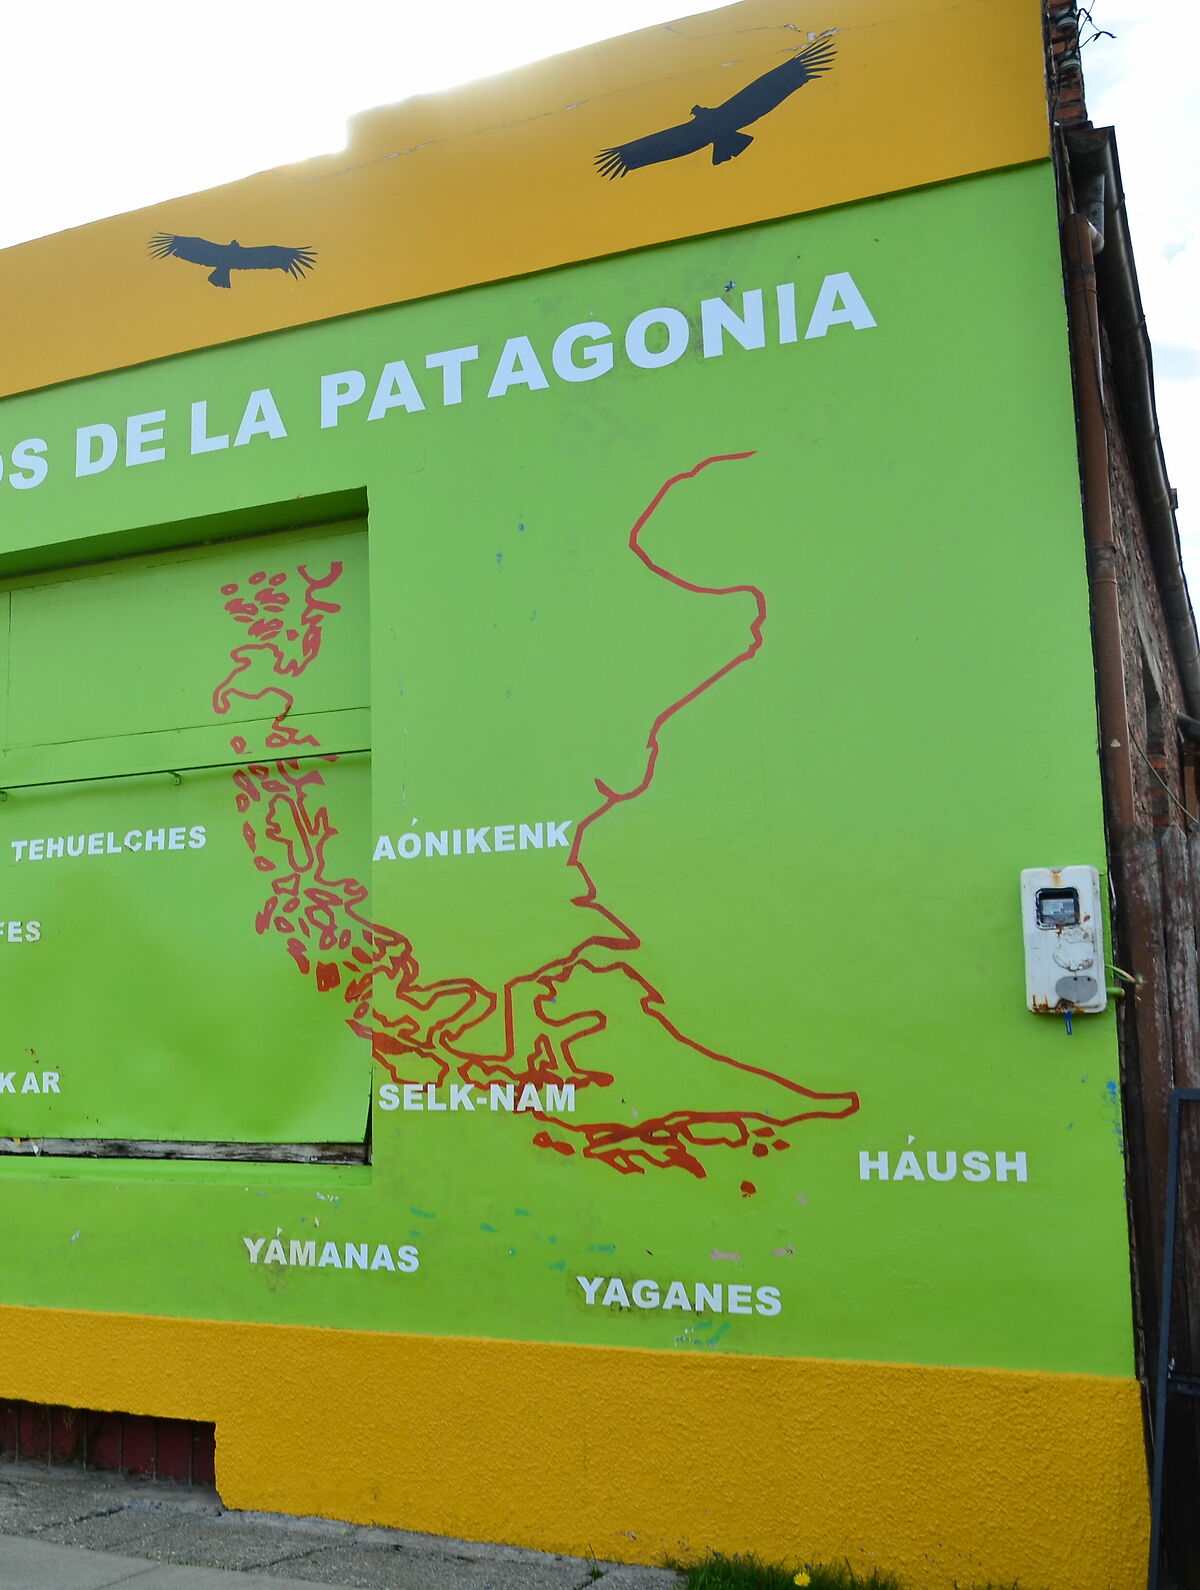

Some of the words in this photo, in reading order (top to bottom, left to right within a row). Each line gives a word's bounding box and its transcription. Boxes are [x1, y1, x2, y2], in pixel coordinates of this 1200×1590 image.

[75, 409, 166, 477] DE
[191, 388, 287, 455] LA
[321, 272, 877, 428] PATAGONIA
[11, 826, 206, 861] TEHUELCHES
[373, 818, 572, 861] AÓNIKENK
[379, 1084, 574, 1111] SELK-NAM
[860, 1136, 1027, 1181] HÁUSH
[244, 1228, 419, 1272] YÁMANAS
[577, 1277, 781, 1315] YAGANES
